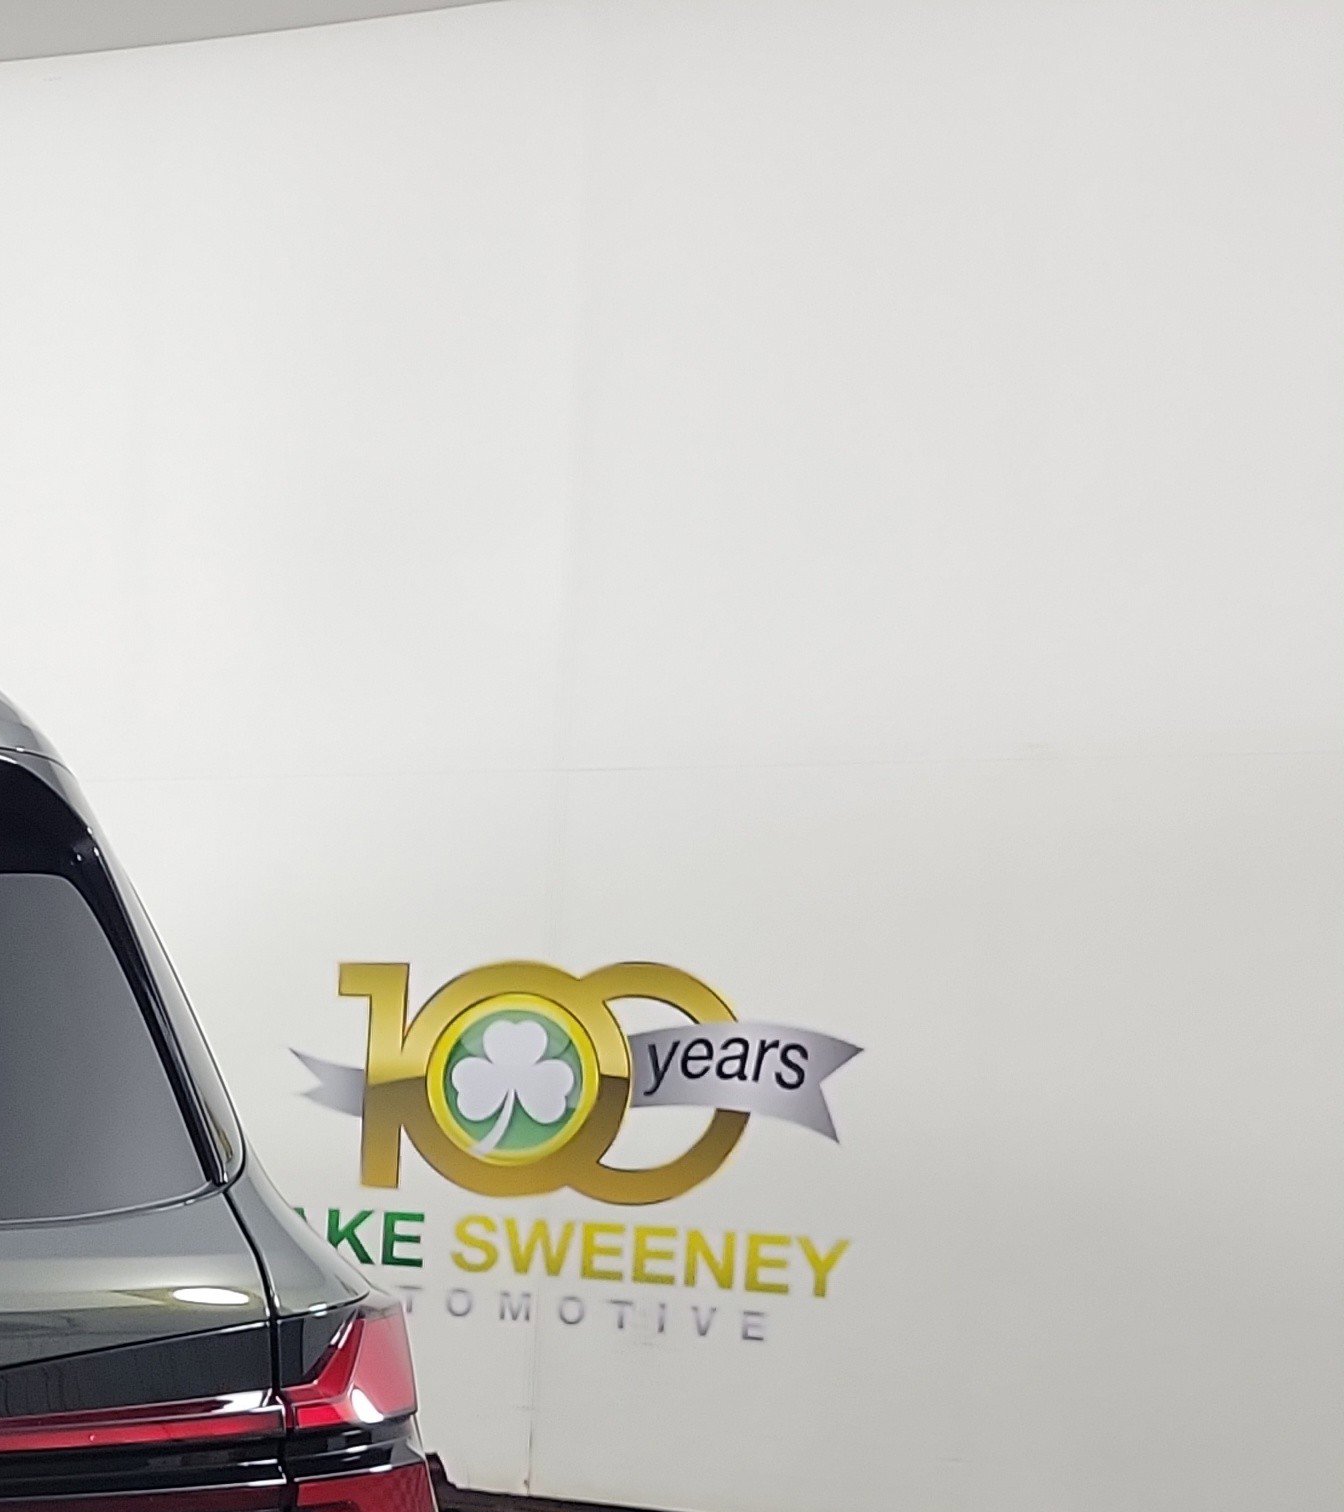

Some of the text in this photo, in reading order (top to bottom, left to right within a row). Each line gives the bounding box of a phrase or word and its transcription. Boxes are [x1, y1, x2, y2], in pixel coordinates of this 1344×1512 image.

[338, 961, 810, 1206] 100 years
[449, 1214, 852, 1298] SWEENEY
[395, 1284, 771, 1342] TOMOTIVE
